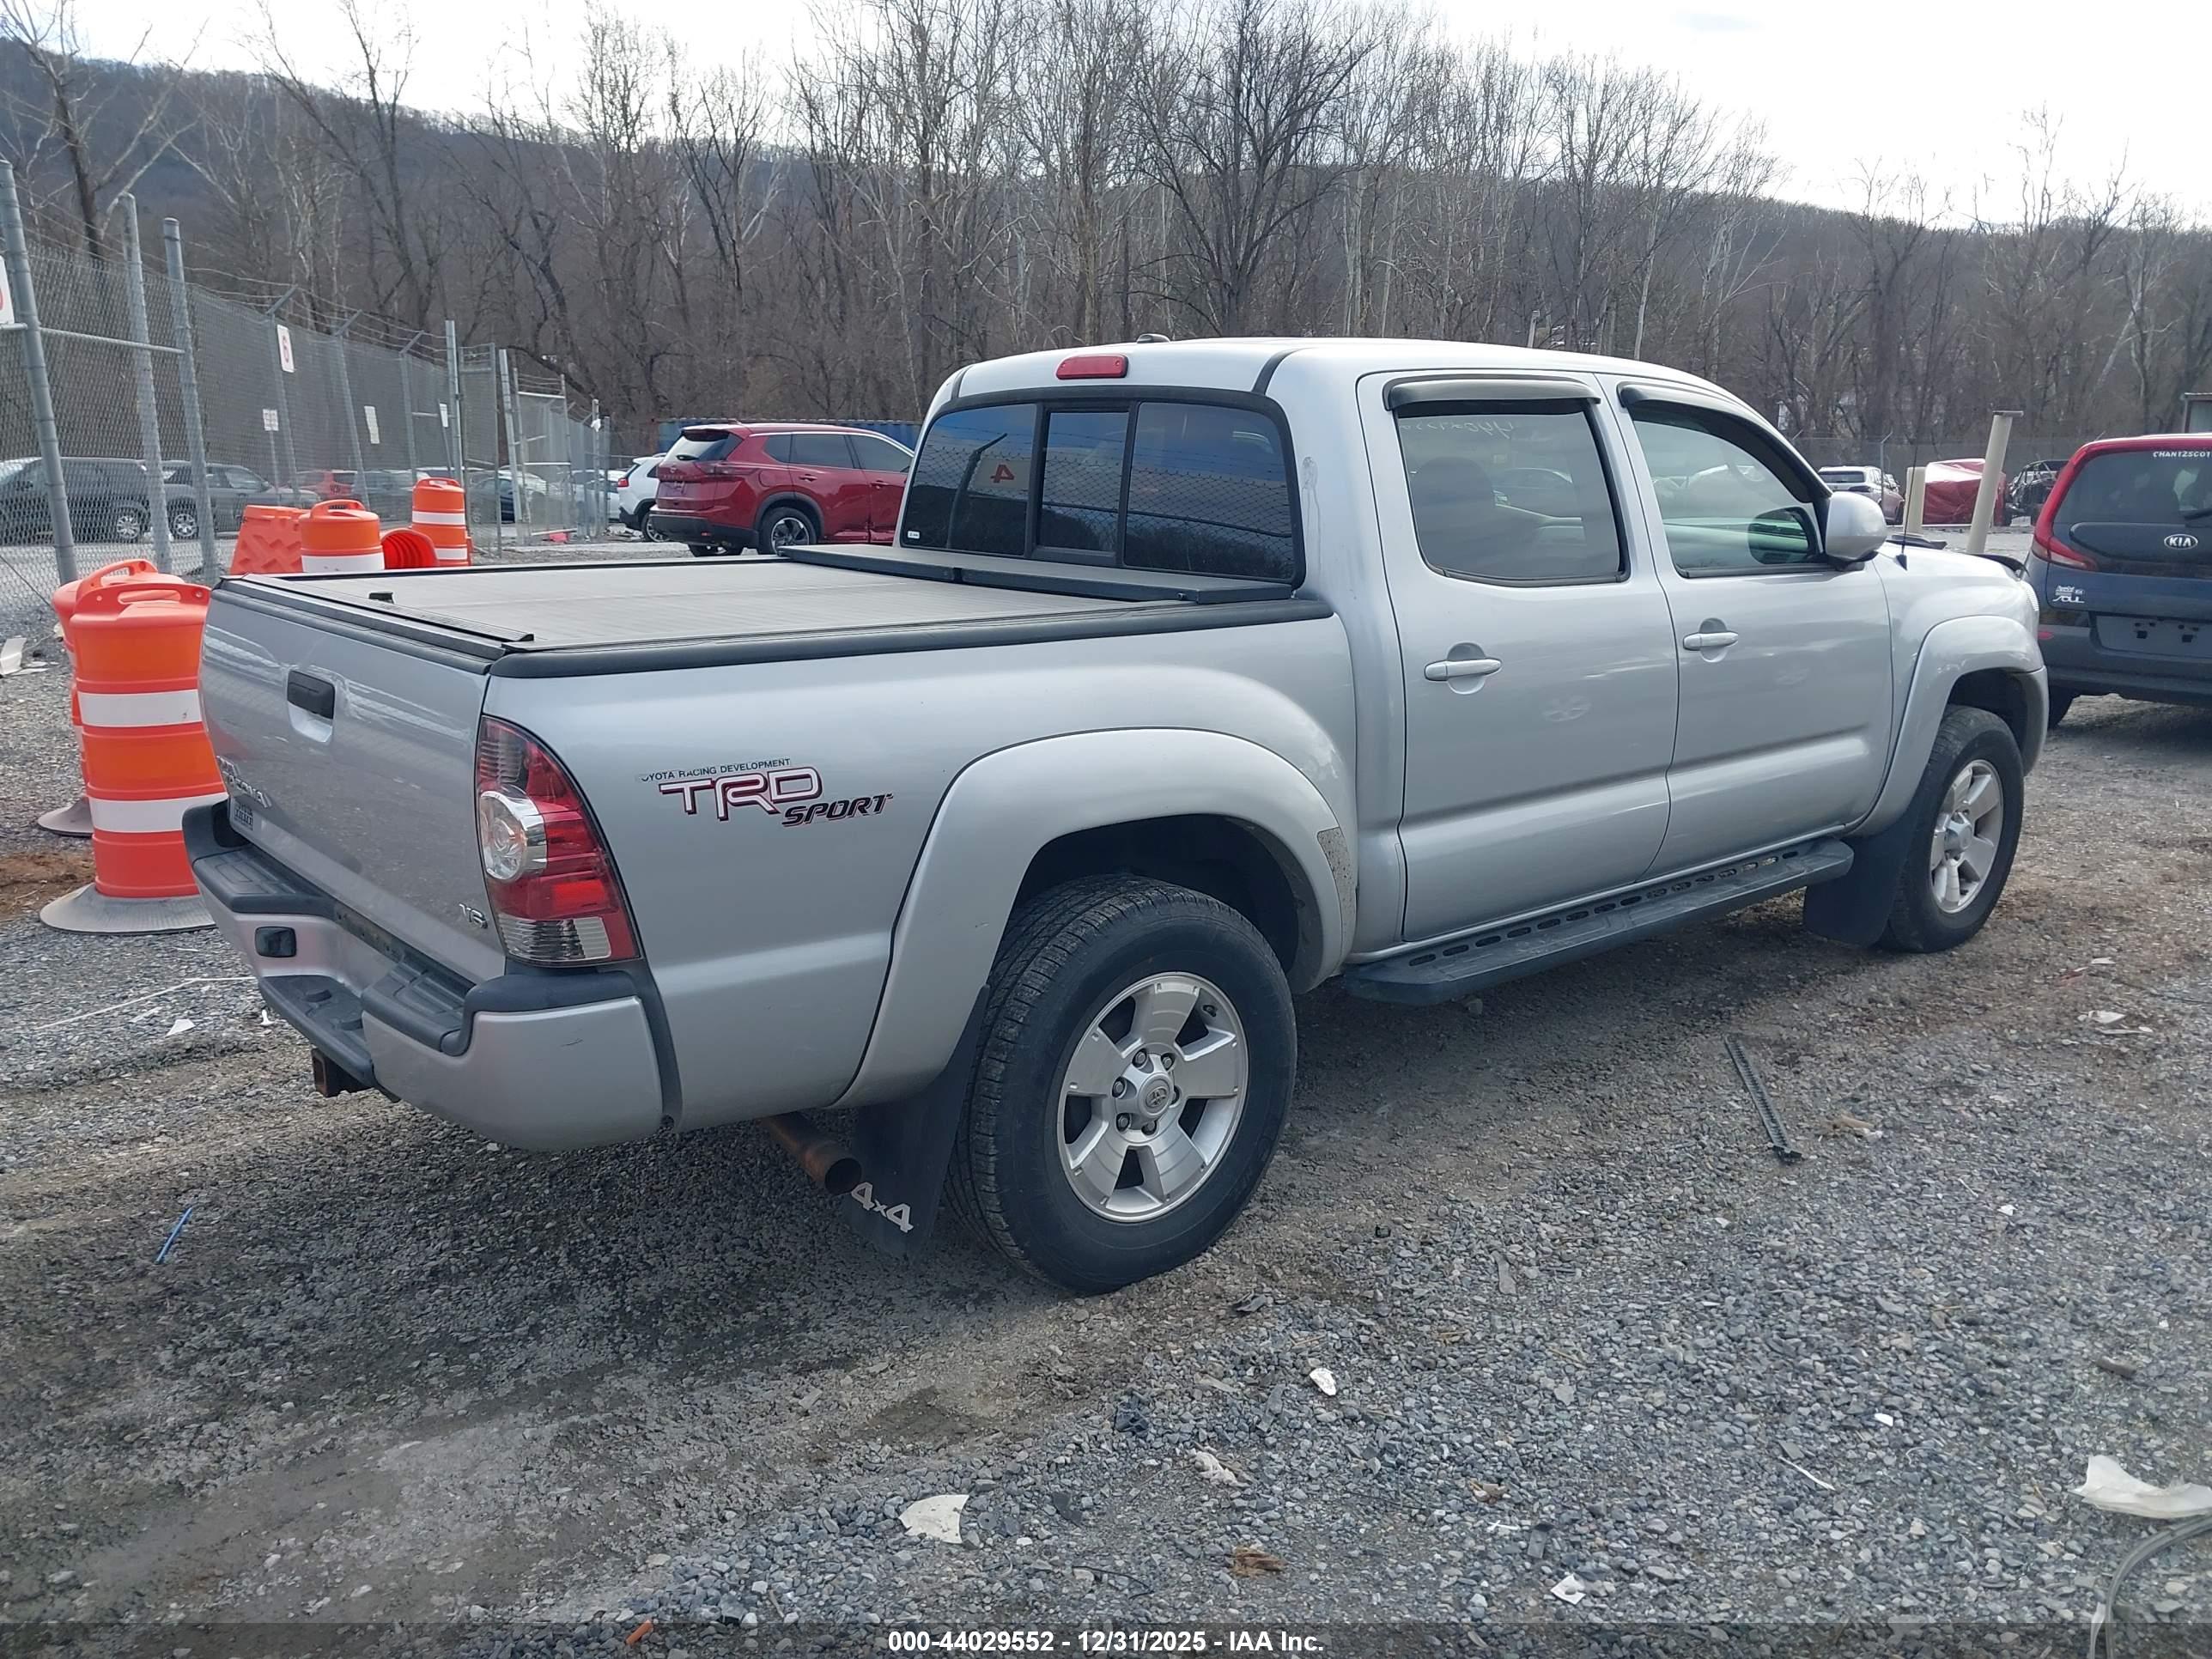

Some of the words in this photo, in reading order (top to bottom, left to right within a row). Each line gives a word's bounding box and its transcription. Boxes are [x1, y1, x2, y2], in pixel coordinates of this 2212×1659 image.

[678, 766, 717, 778] RACING
[720, 758, 791, 774] DEVELOPMENT
[659, 767, 823, 822] TRD
[781, 793, 894, 827] SPORT
